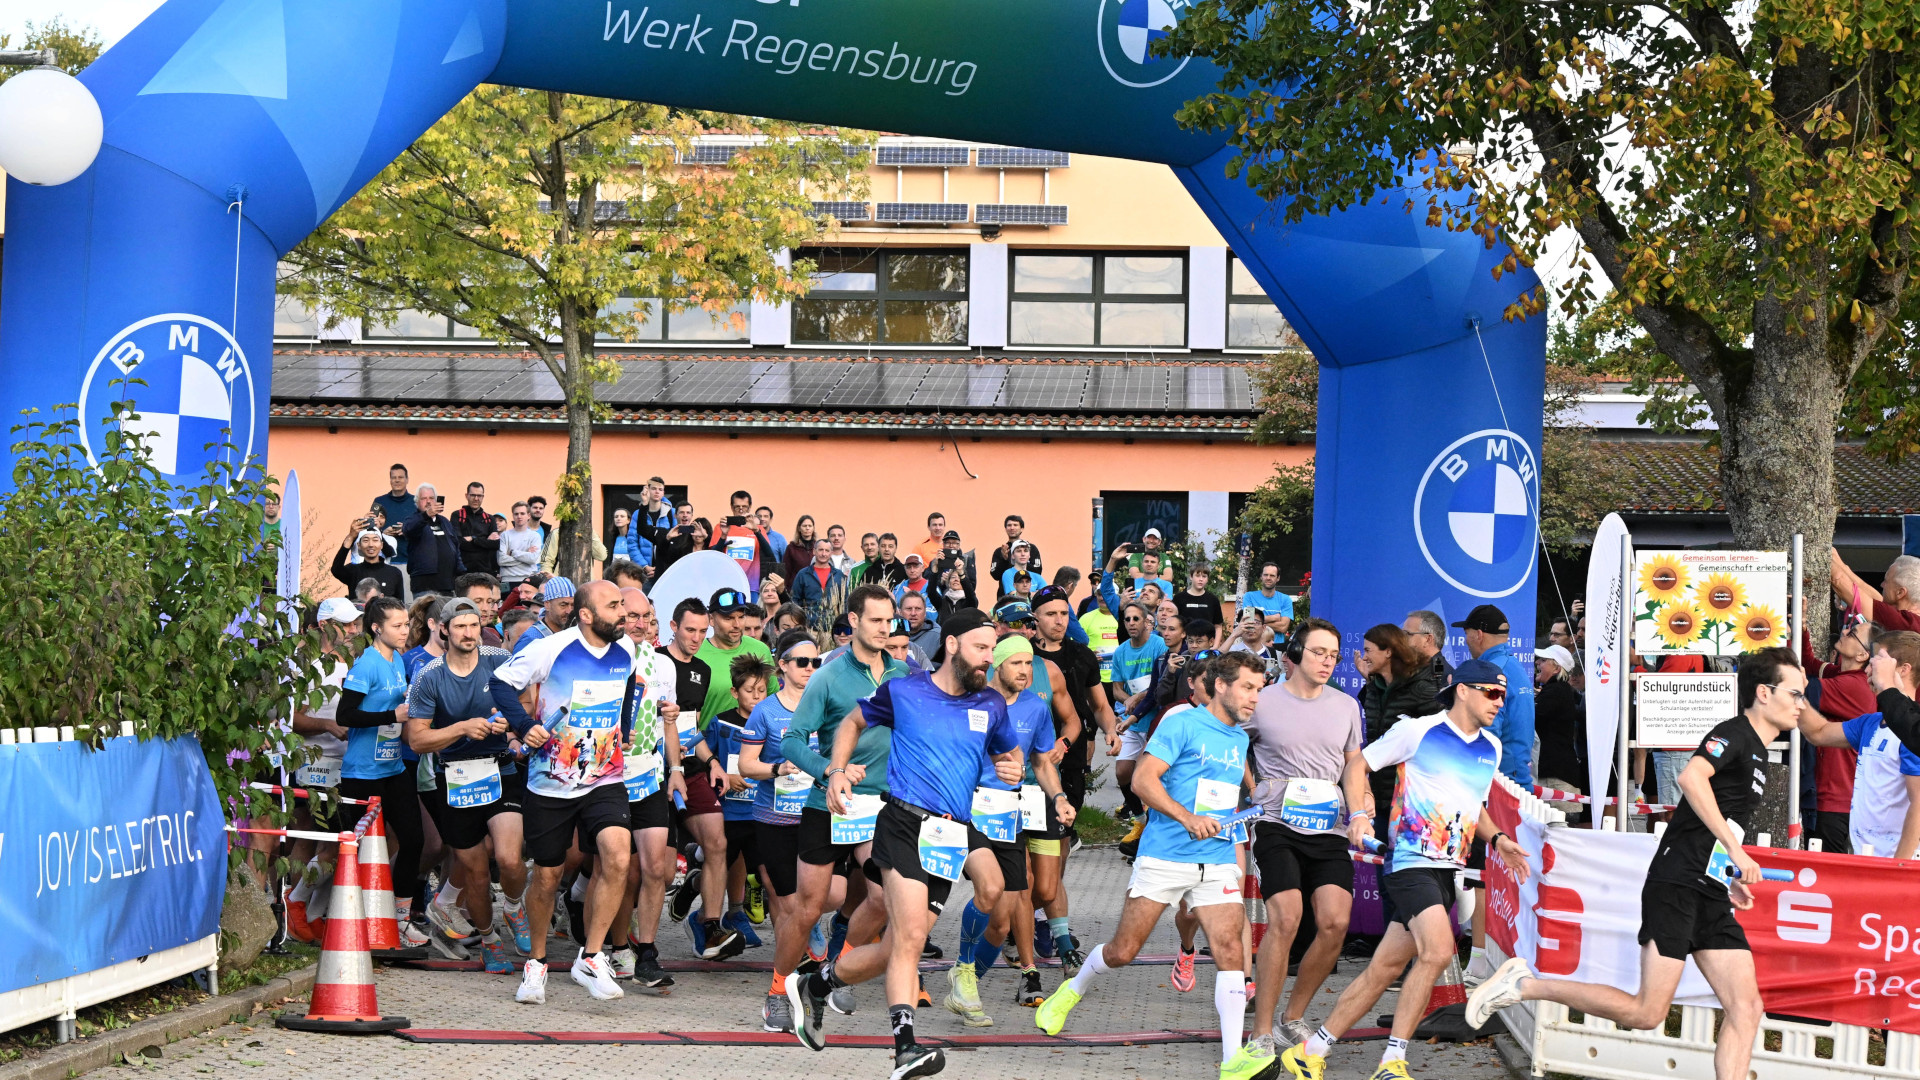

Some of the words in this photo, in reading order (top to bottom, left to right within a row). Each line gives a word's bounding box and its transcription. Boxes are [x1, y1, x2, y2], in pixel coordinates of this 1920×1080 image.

[602, 0, 713, 54] Werk
[721, 18, 978, 96] Regensburg
[109, 324, 243, 383] BMW
[1440, 438, 1534, 484] BMW
[1682, 554, 1726, 562] Gemeinsam
[1729, 553, 1759, 562] lernen-
[1698, 564, 1753, 572] Gemeinschaft
[1756, 564, 1787, 572] erleben
[1602, 575, 1617, 643] Landkreis
[1643, 681, 1731, 694] Schulgrundstück
[579, 716, 592, 727] 34
[601, 717, 612, 727] 01
[381, 748, 394, 758] 262
[310, 774, 326, 784] 534
[639, 787, 650, 798] 01
[455, 794, 475, 806] 134
[480, 792, 493, 802] 01
[782, 801, 800, 812] 235
[1291, 816, 1310, 827] 275
[1315, 818, 1328, 830] 01
[840, 831, 861, 841] 119
[998, 828, 1008, 838] 01
[36, 829, 79, 899] JOY
[84, 826, 103, 883] IS
[105, 810, 203, 879] ELECTRIC.
[926, 857, 937, 869] 73
[943, 866, 953, 877] 01
